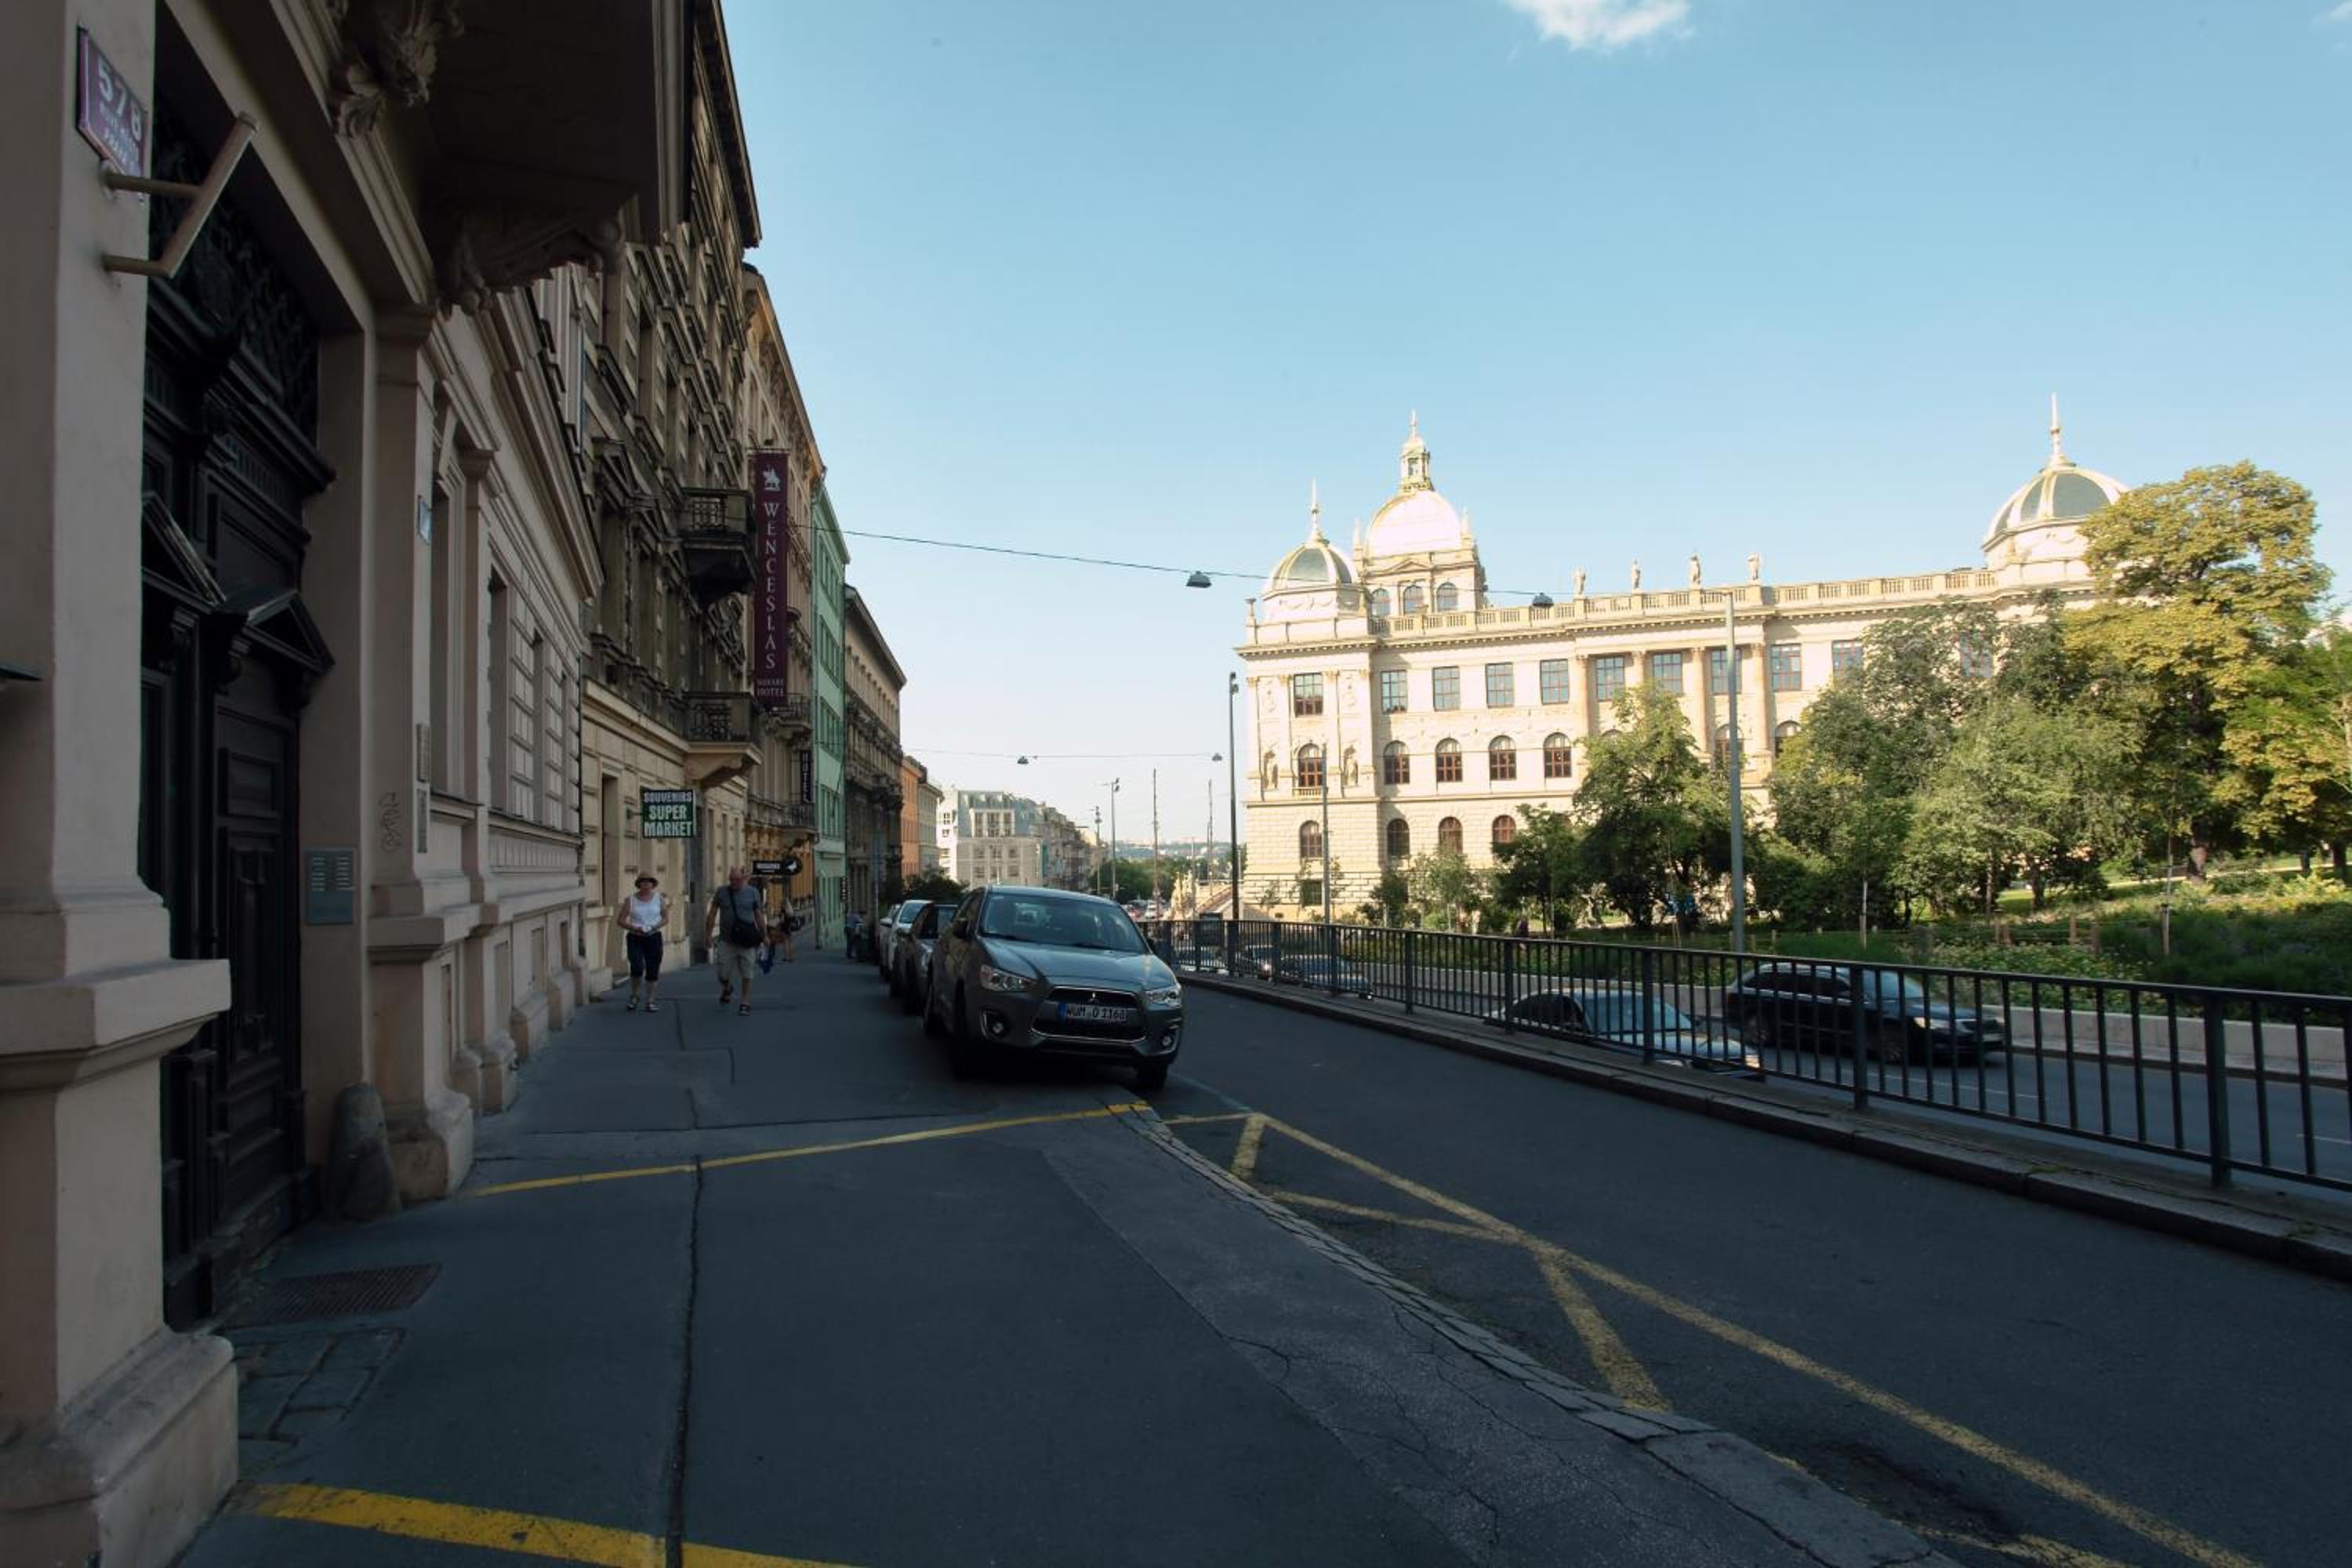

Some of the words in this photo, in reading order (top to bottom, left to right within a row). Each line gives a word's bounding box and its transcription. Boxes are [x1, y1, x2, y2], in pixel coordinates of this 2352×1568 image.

[764, 502, 779, 669] WENCESLAS
[644, 792, 691, 803] SOUVENIRS
[649, 804, 687, 821] SUPER
[644, 821, 691, 837] MARKET
